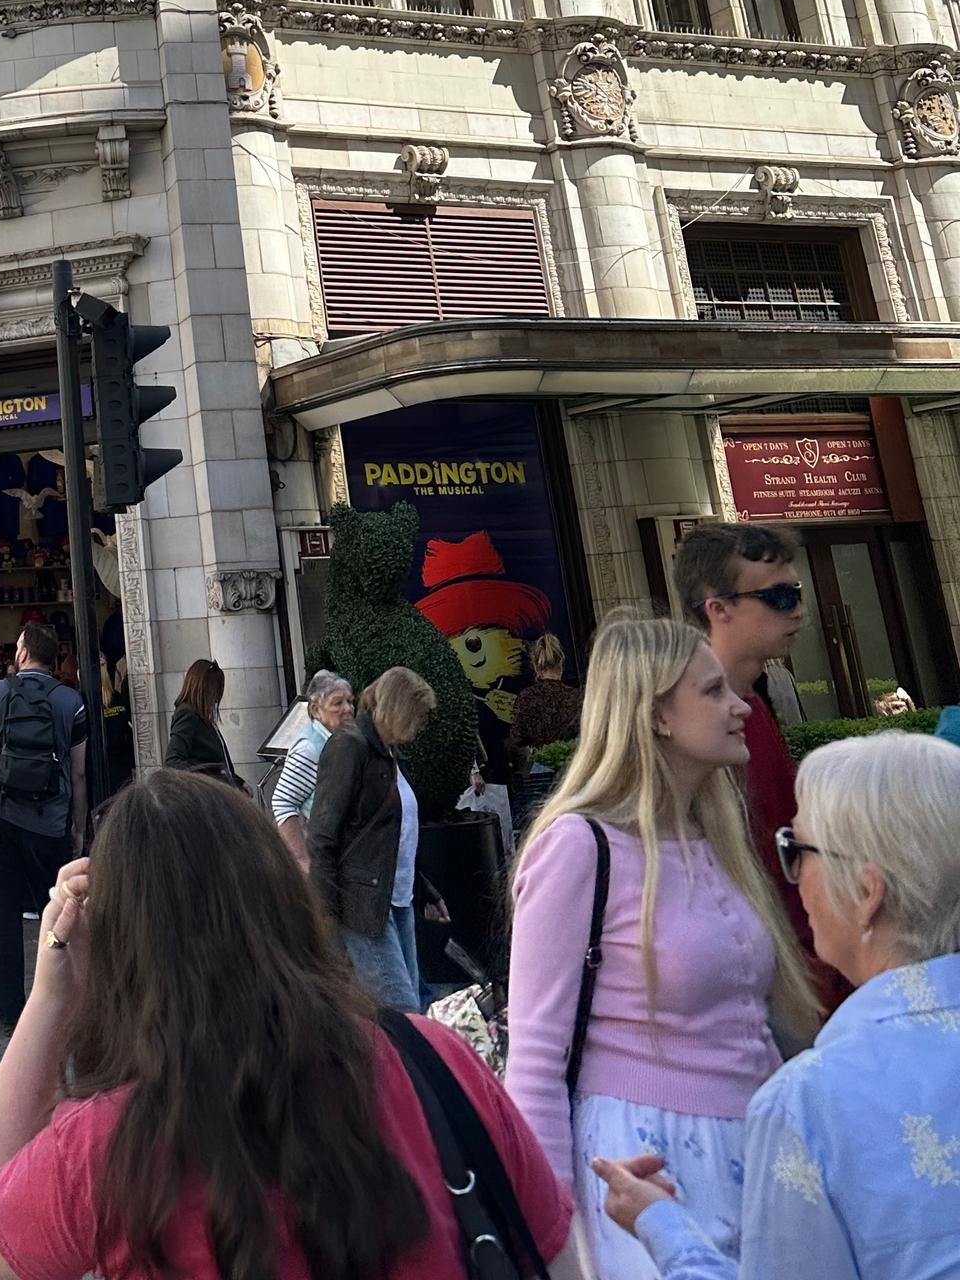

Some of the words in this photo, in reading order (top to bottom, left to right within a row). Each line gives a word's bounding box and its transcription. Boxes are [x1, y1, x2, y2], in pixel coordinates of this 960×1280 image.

[742, 443, 763, 451] OPEN
[769, 442, 789, 451] DAYS
[826, 440, 847, 449] OPEN
[847, 440, 852, 448] 7
[852, 439, 871, 448] DAYS
[413, 487, 435, 496] THE
[439, 486, 485, 496] MUSICAL
[753, 490, 778, 498] FITNESS
[799, 489, 835, 497] STEAMROOM
